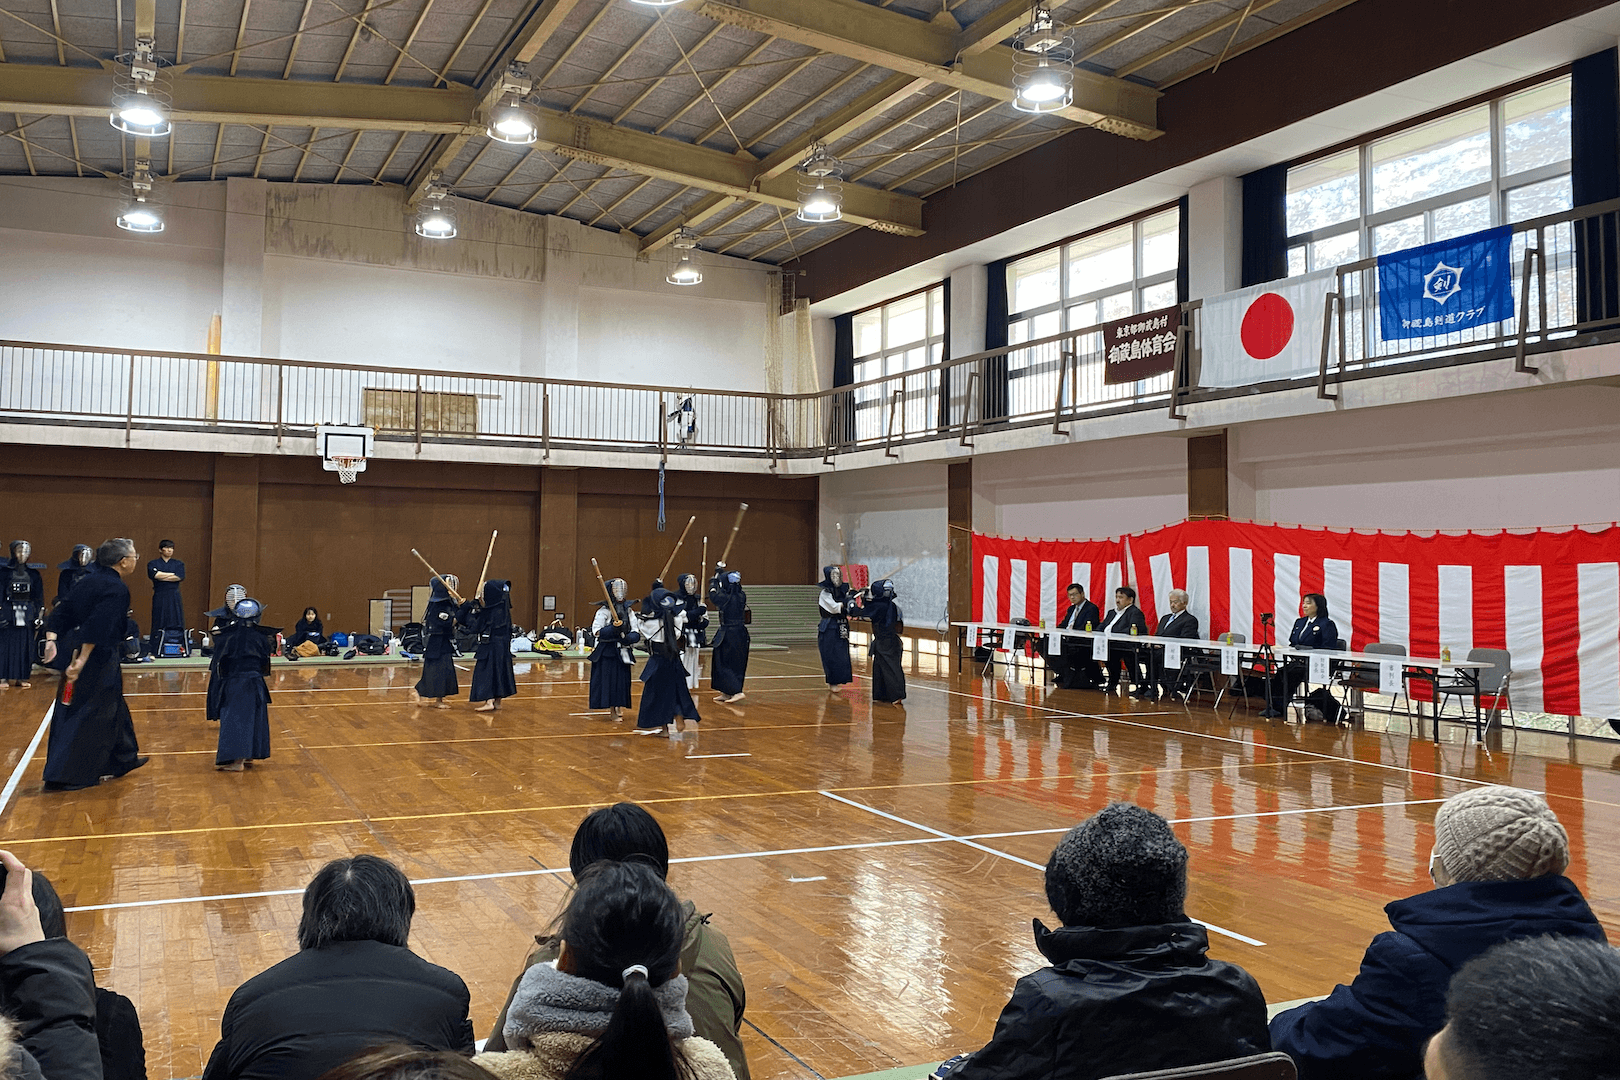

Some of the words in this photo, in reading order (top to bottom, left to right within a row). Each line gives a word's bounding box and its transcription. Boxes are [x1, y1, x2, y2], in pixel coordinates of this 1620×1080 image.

[1433, 274, 1451, 292] 剣
[1108, 331, 1177, 364] 御蔵島体育会
